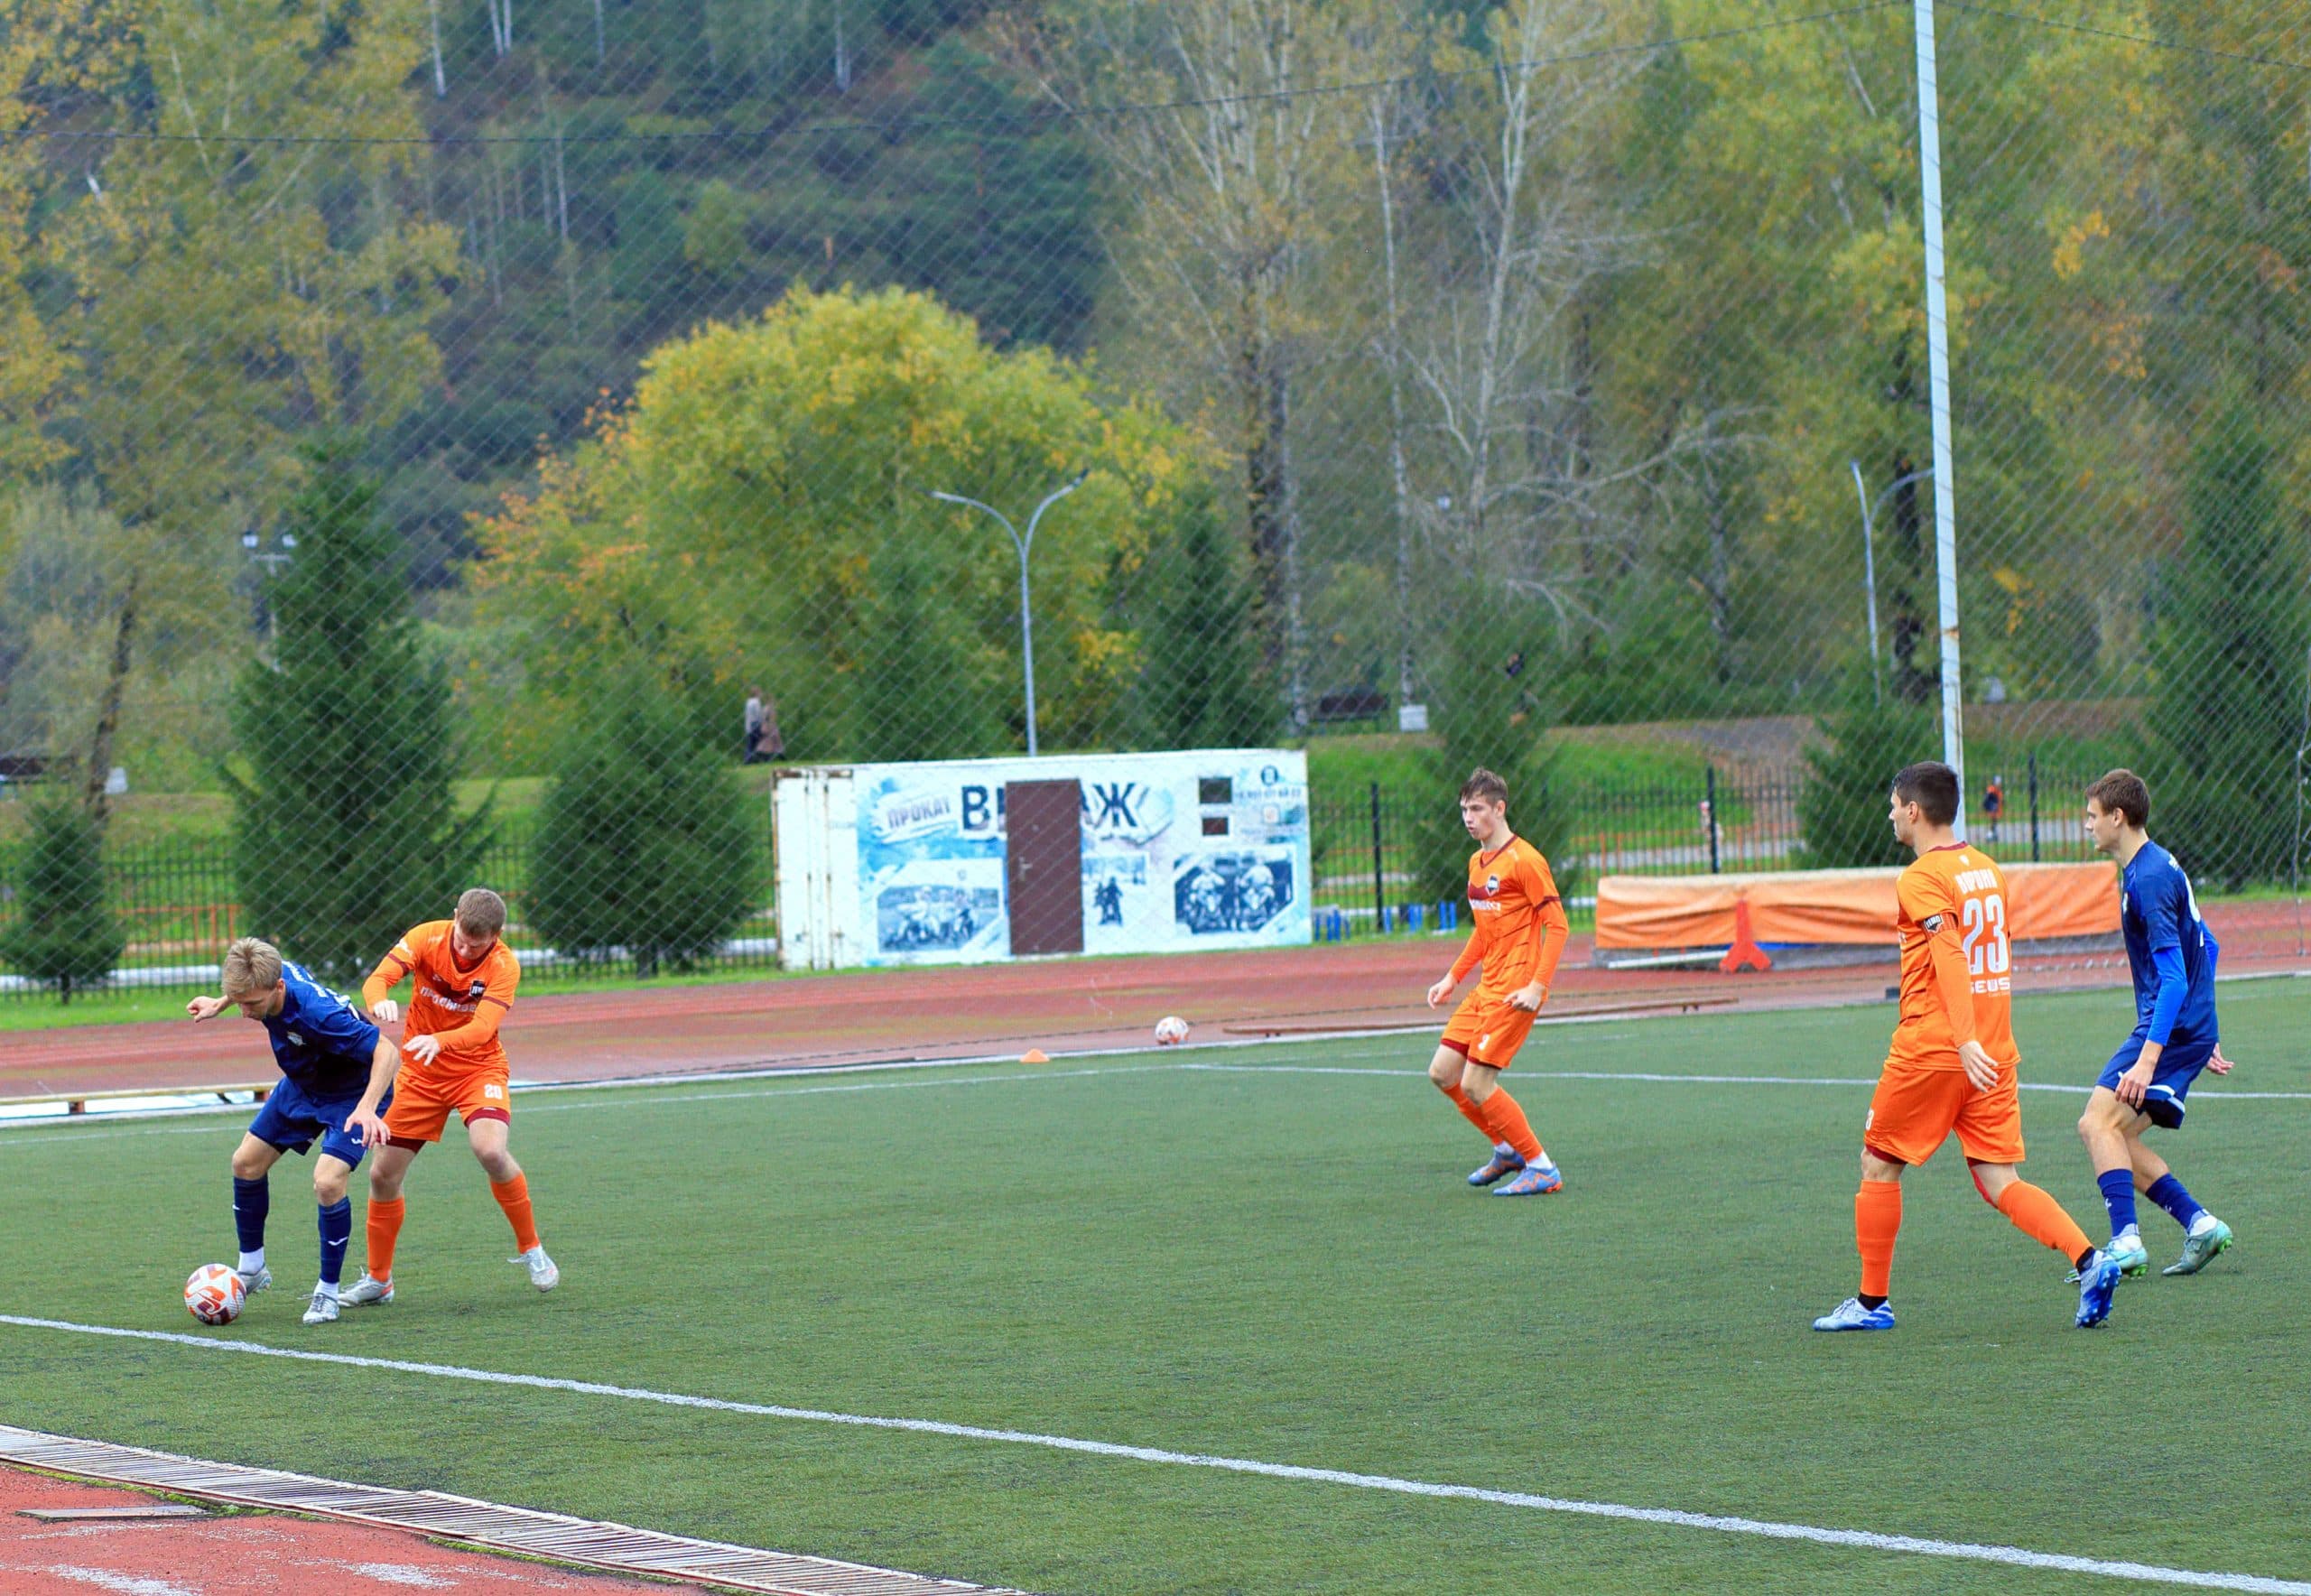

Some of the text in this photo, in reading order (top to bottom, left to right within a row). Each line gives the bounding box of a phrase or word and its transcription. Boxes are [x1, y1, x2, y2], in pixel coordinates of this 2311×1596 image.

[887, 795, 951, 828] ПРОКАТ
[1963, 894, 2009, 976] 23
[484, 1083, 503, 1100] 20
